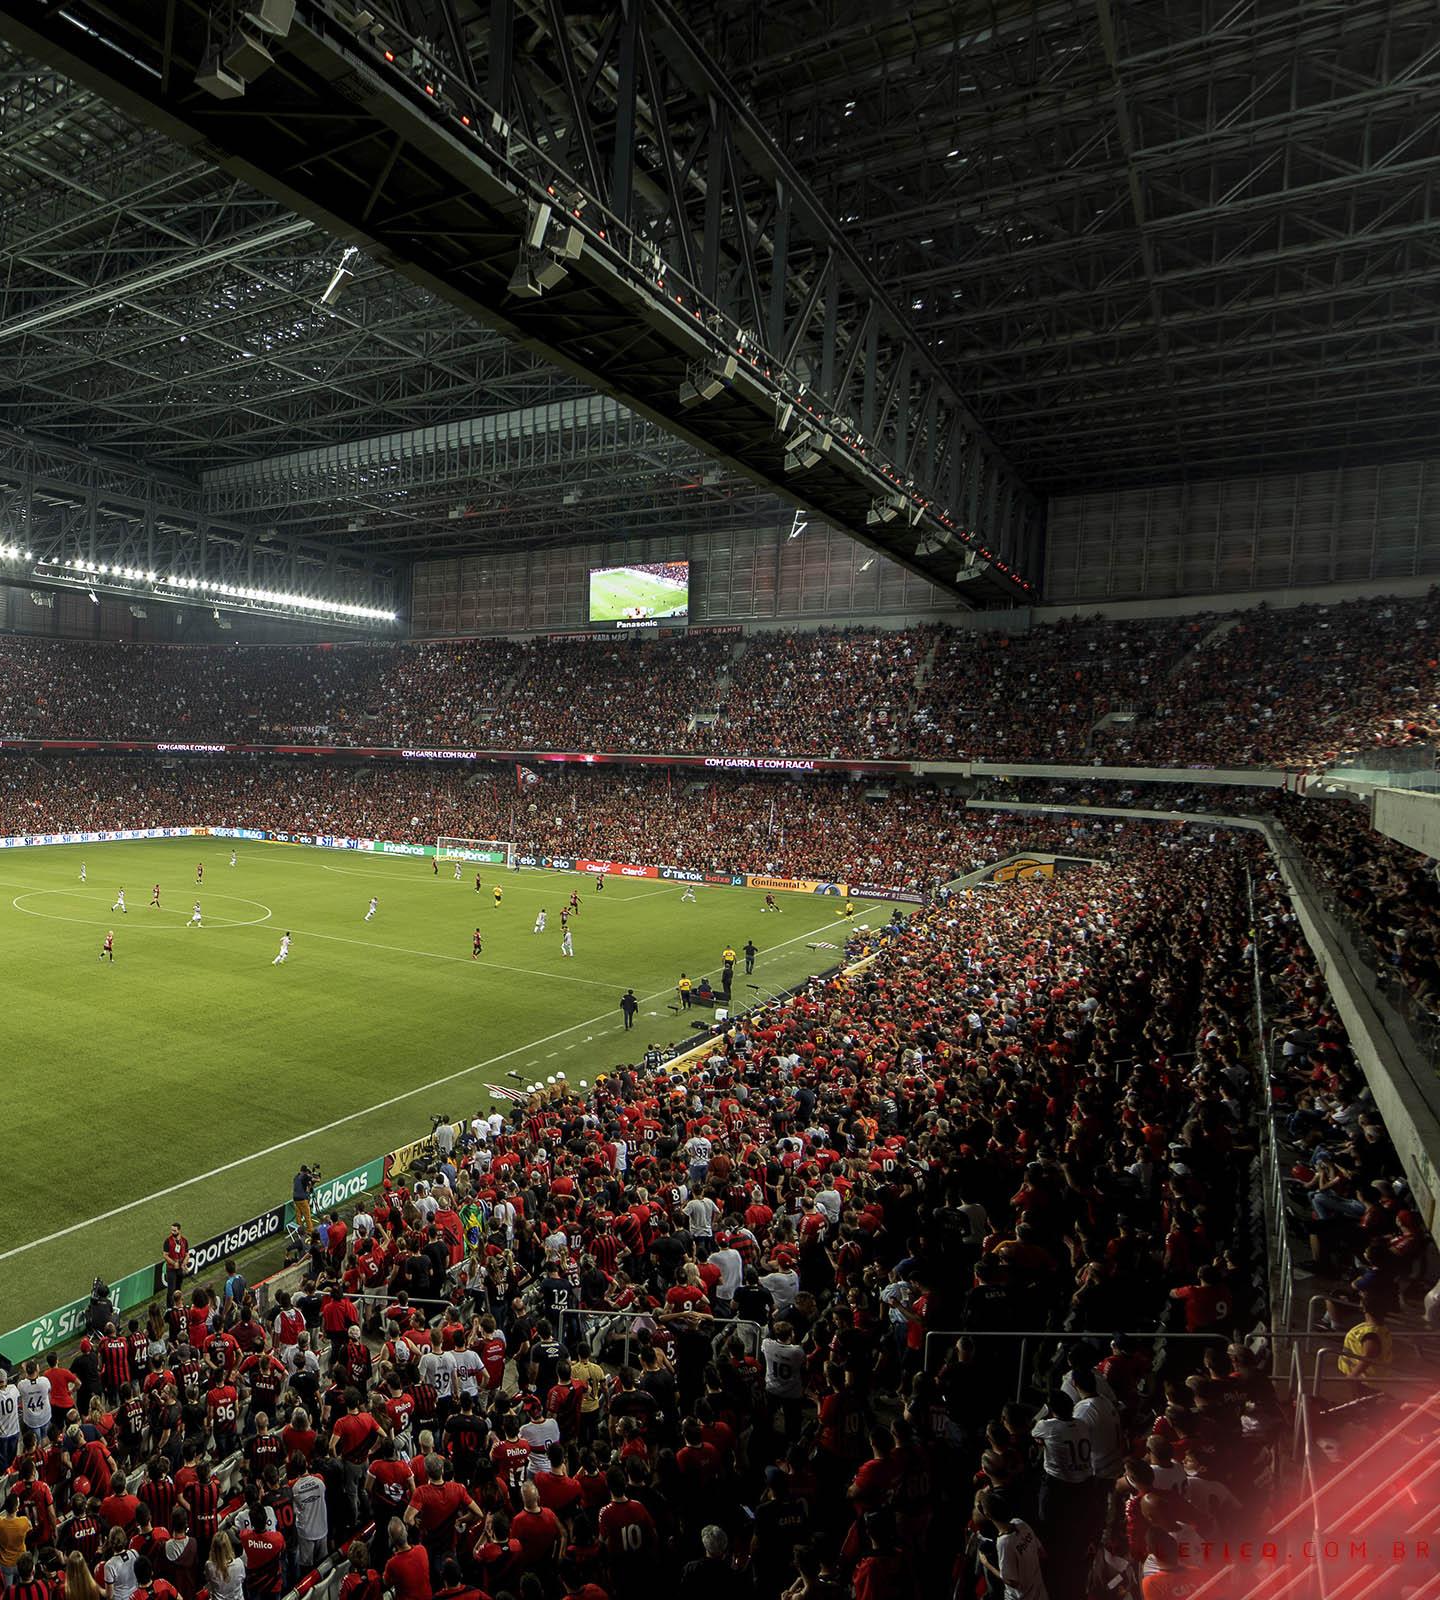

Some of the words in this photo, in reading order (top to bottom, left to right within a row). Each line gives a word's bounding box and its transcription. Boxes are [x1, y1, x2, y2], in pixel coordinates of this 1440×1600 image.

[617, 620, 658, 628] Panasonic
[705, 758, 724, 766] COM
[725, 759, 755, 767] GARRA
[764, 760, 785, 768] COM
[81, 834, 89, 842] Sil
[98, 832, 106, 840] Sil
[115, 831, 123, 839] Sil
[147, 829, 155, 837] Sil
[163, 828, 171, 836] Sil
[243, 829, 262, 839] MAG
[5, 838, 14, 847] Sil
[24, 837, 34, 845] Sil
[43, 836, 53, 844] Sil
[62, 835, 71, 843] Sil
[322, 836, 333, 847] Sil
[346, 838, 358, 849] Sil
[383, 841, 424, 855] intelbras
[586, 863, 608, 873] Claro
[622, 867, 645, 877] Claro
[673, 870, 702, 881] TikTok
[751, 877, 800, 889] Continental
[643, 1129, 654, 1140] 10
[882, 1159, 895, 1172] 10
[671, 1189, 680, 1200] 8
[186, 1213, 279, 1274] Sportsbet.io
[570, 1234, 581, 1249] 10
[369, 1263, 379, 1275] 9
[552, 1289, 568, 1304] 12
[684, 1300, 693, 1312] 9
[1214, 1300, 1228, 1319] 9
[179, 1316, 187, 1330] 3
[134, 1347, 148, 1363] 44
[667, 1341, 676, 1360] 5
[216, 1352, 226, 1367] 9
[183, 1371, 200, 1387] 52
[434, 1372, 450, 1389] 39
[0, 1397, 13, 1416] 10
[27, 1395, 44, 1411] 44
[394, 1402, 411, 1414] Philco
[216, 1403, 235, 1423] 96
[130, 1416, 143, 1433] 15
[399, 1413, 409, 1430] 9
[256, 1446, 277, 1454] CAIXA
[506, 1447, 528, 1457] Philco
[1065, 1438, 1092, 1463] 10
[276, 1506, 294, 1525] 10
[74, 1527, 96, 1540] CAIXA
[621, 1523, 642, 1551] 10
[248, 1539, 273, 1550] Philco
